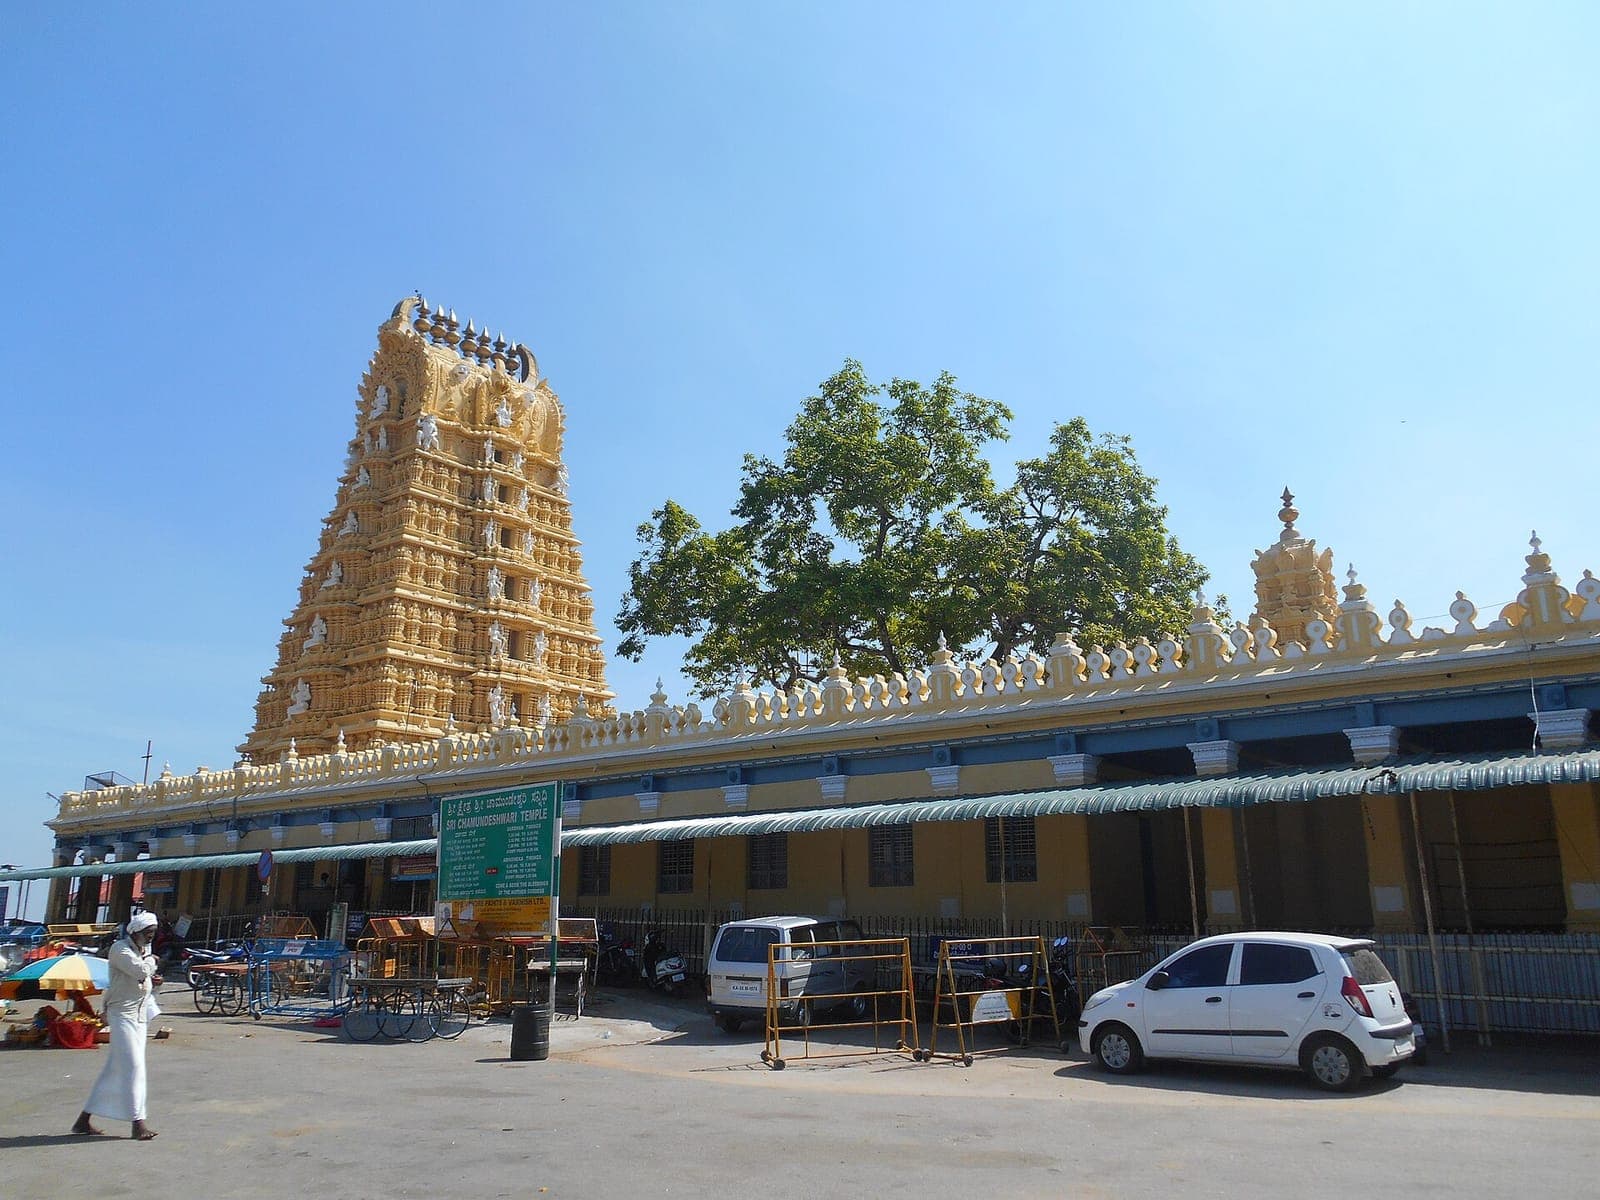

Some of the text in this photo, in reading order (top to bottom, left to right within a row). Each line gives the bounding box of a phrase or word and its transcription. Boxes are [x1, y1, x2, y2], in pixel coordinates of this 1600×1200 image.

[446, 808, 548, 830] SRI CHAMUNDESHWARI TEMPLE
